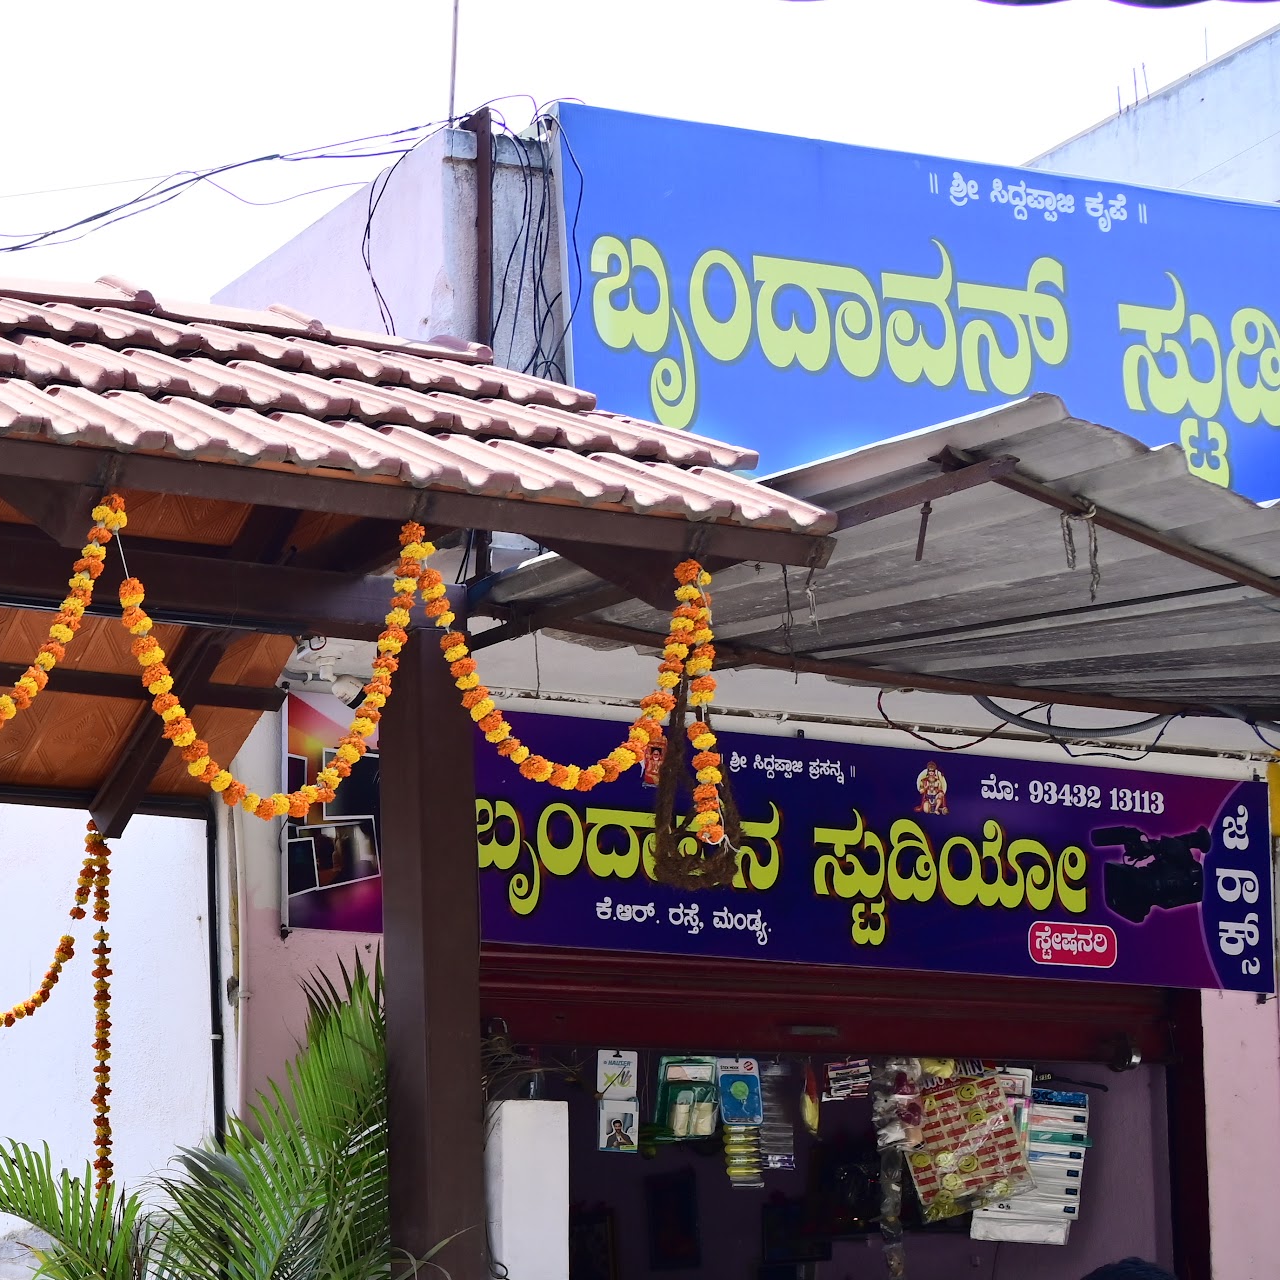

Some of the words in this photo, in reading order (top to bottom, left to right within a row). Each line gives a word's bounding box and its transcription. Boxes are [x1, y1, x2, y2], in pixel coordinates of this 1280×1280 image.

[950, 171, 980, 206] ಶ್ರೀ
[1085, 191, 1128, 233] ಕೃಪೆ
[590, 235, 1069, 431] ಬೃಂದಾವನ್
[730, 752, 747, 772] ಶ್ರೀ
[809, 759, 845, 785] ಪ್ರಸನ್ನ
[1029, 780, 1101, 808] 93432
[1110, 788, 1165, 814] 13113
[813, 808, 1087, 946] ಸ್ಟುಡಿಯೋ
